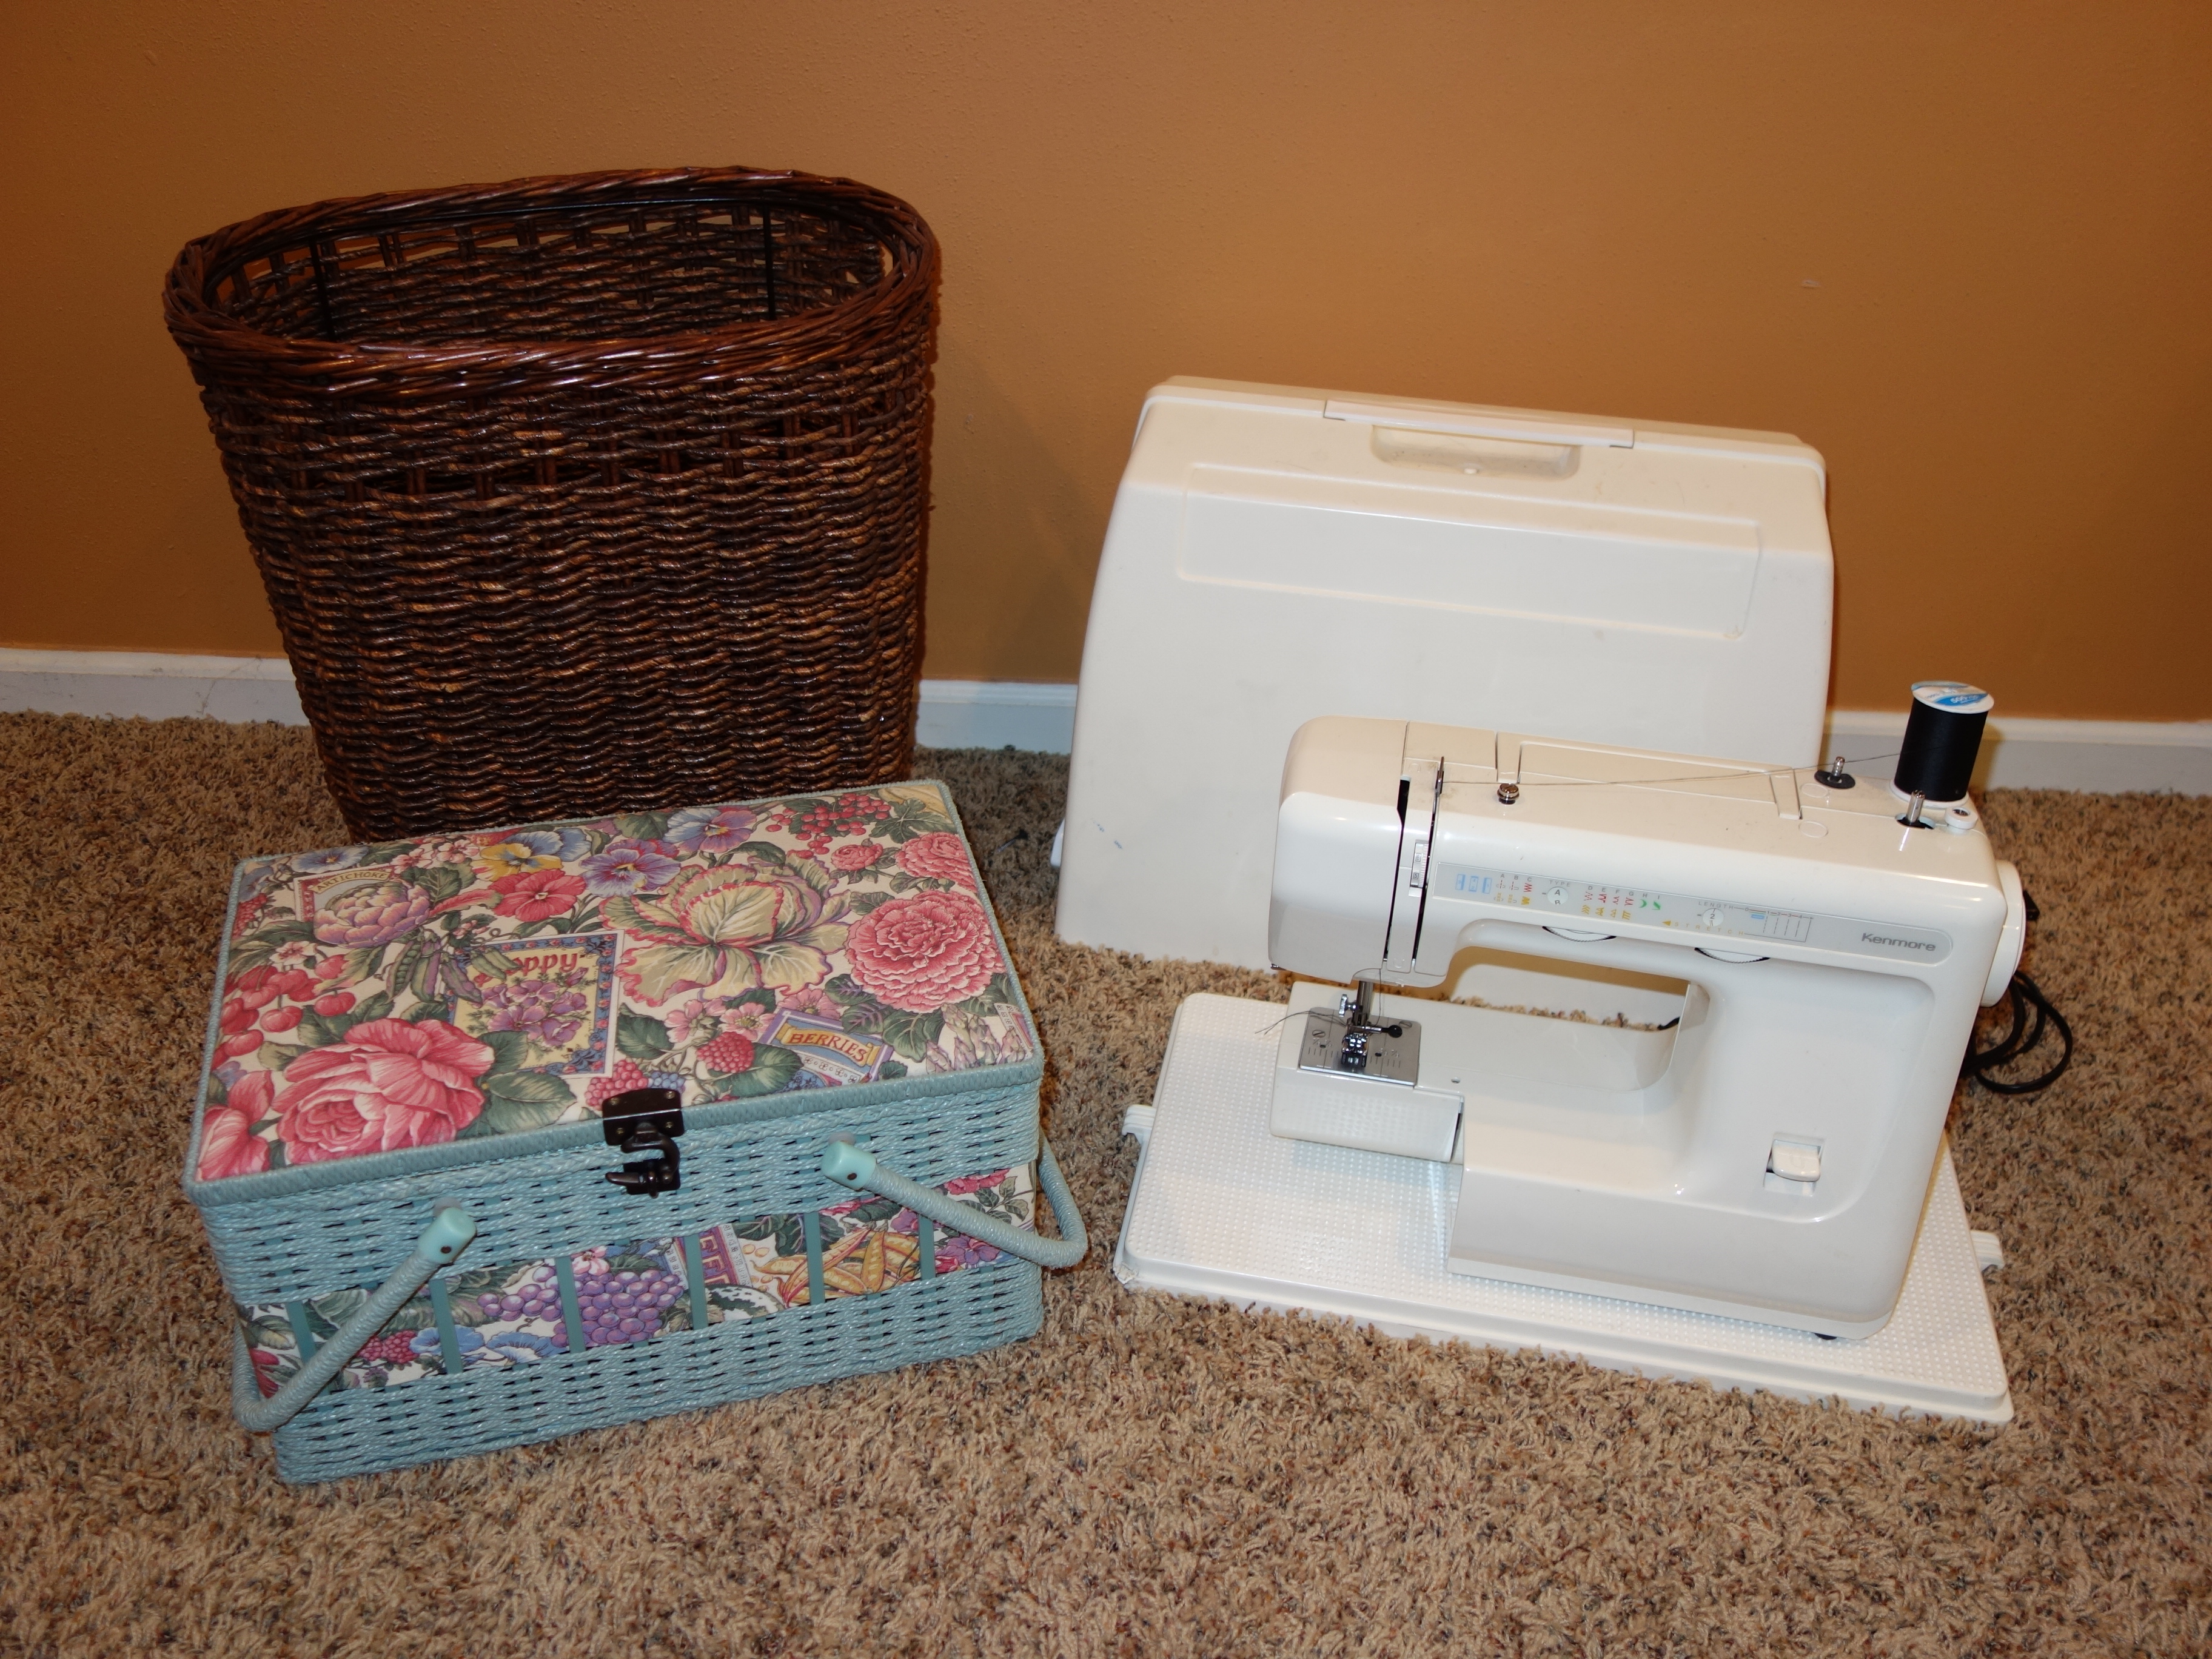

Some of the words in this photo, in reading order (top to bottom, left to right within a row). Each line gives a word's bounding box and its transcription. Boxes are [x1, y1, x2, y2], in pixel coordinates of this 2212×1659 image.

[317, 872, 386, 892] ARTICHOKE
[1698, 901, 1734, 910] LENGTH
[1674, 922, 1744, 936] STRETCH
[1862, 932, 1936, 951] Kenmore
[788, 1033, 868, 1062] BERRIES
